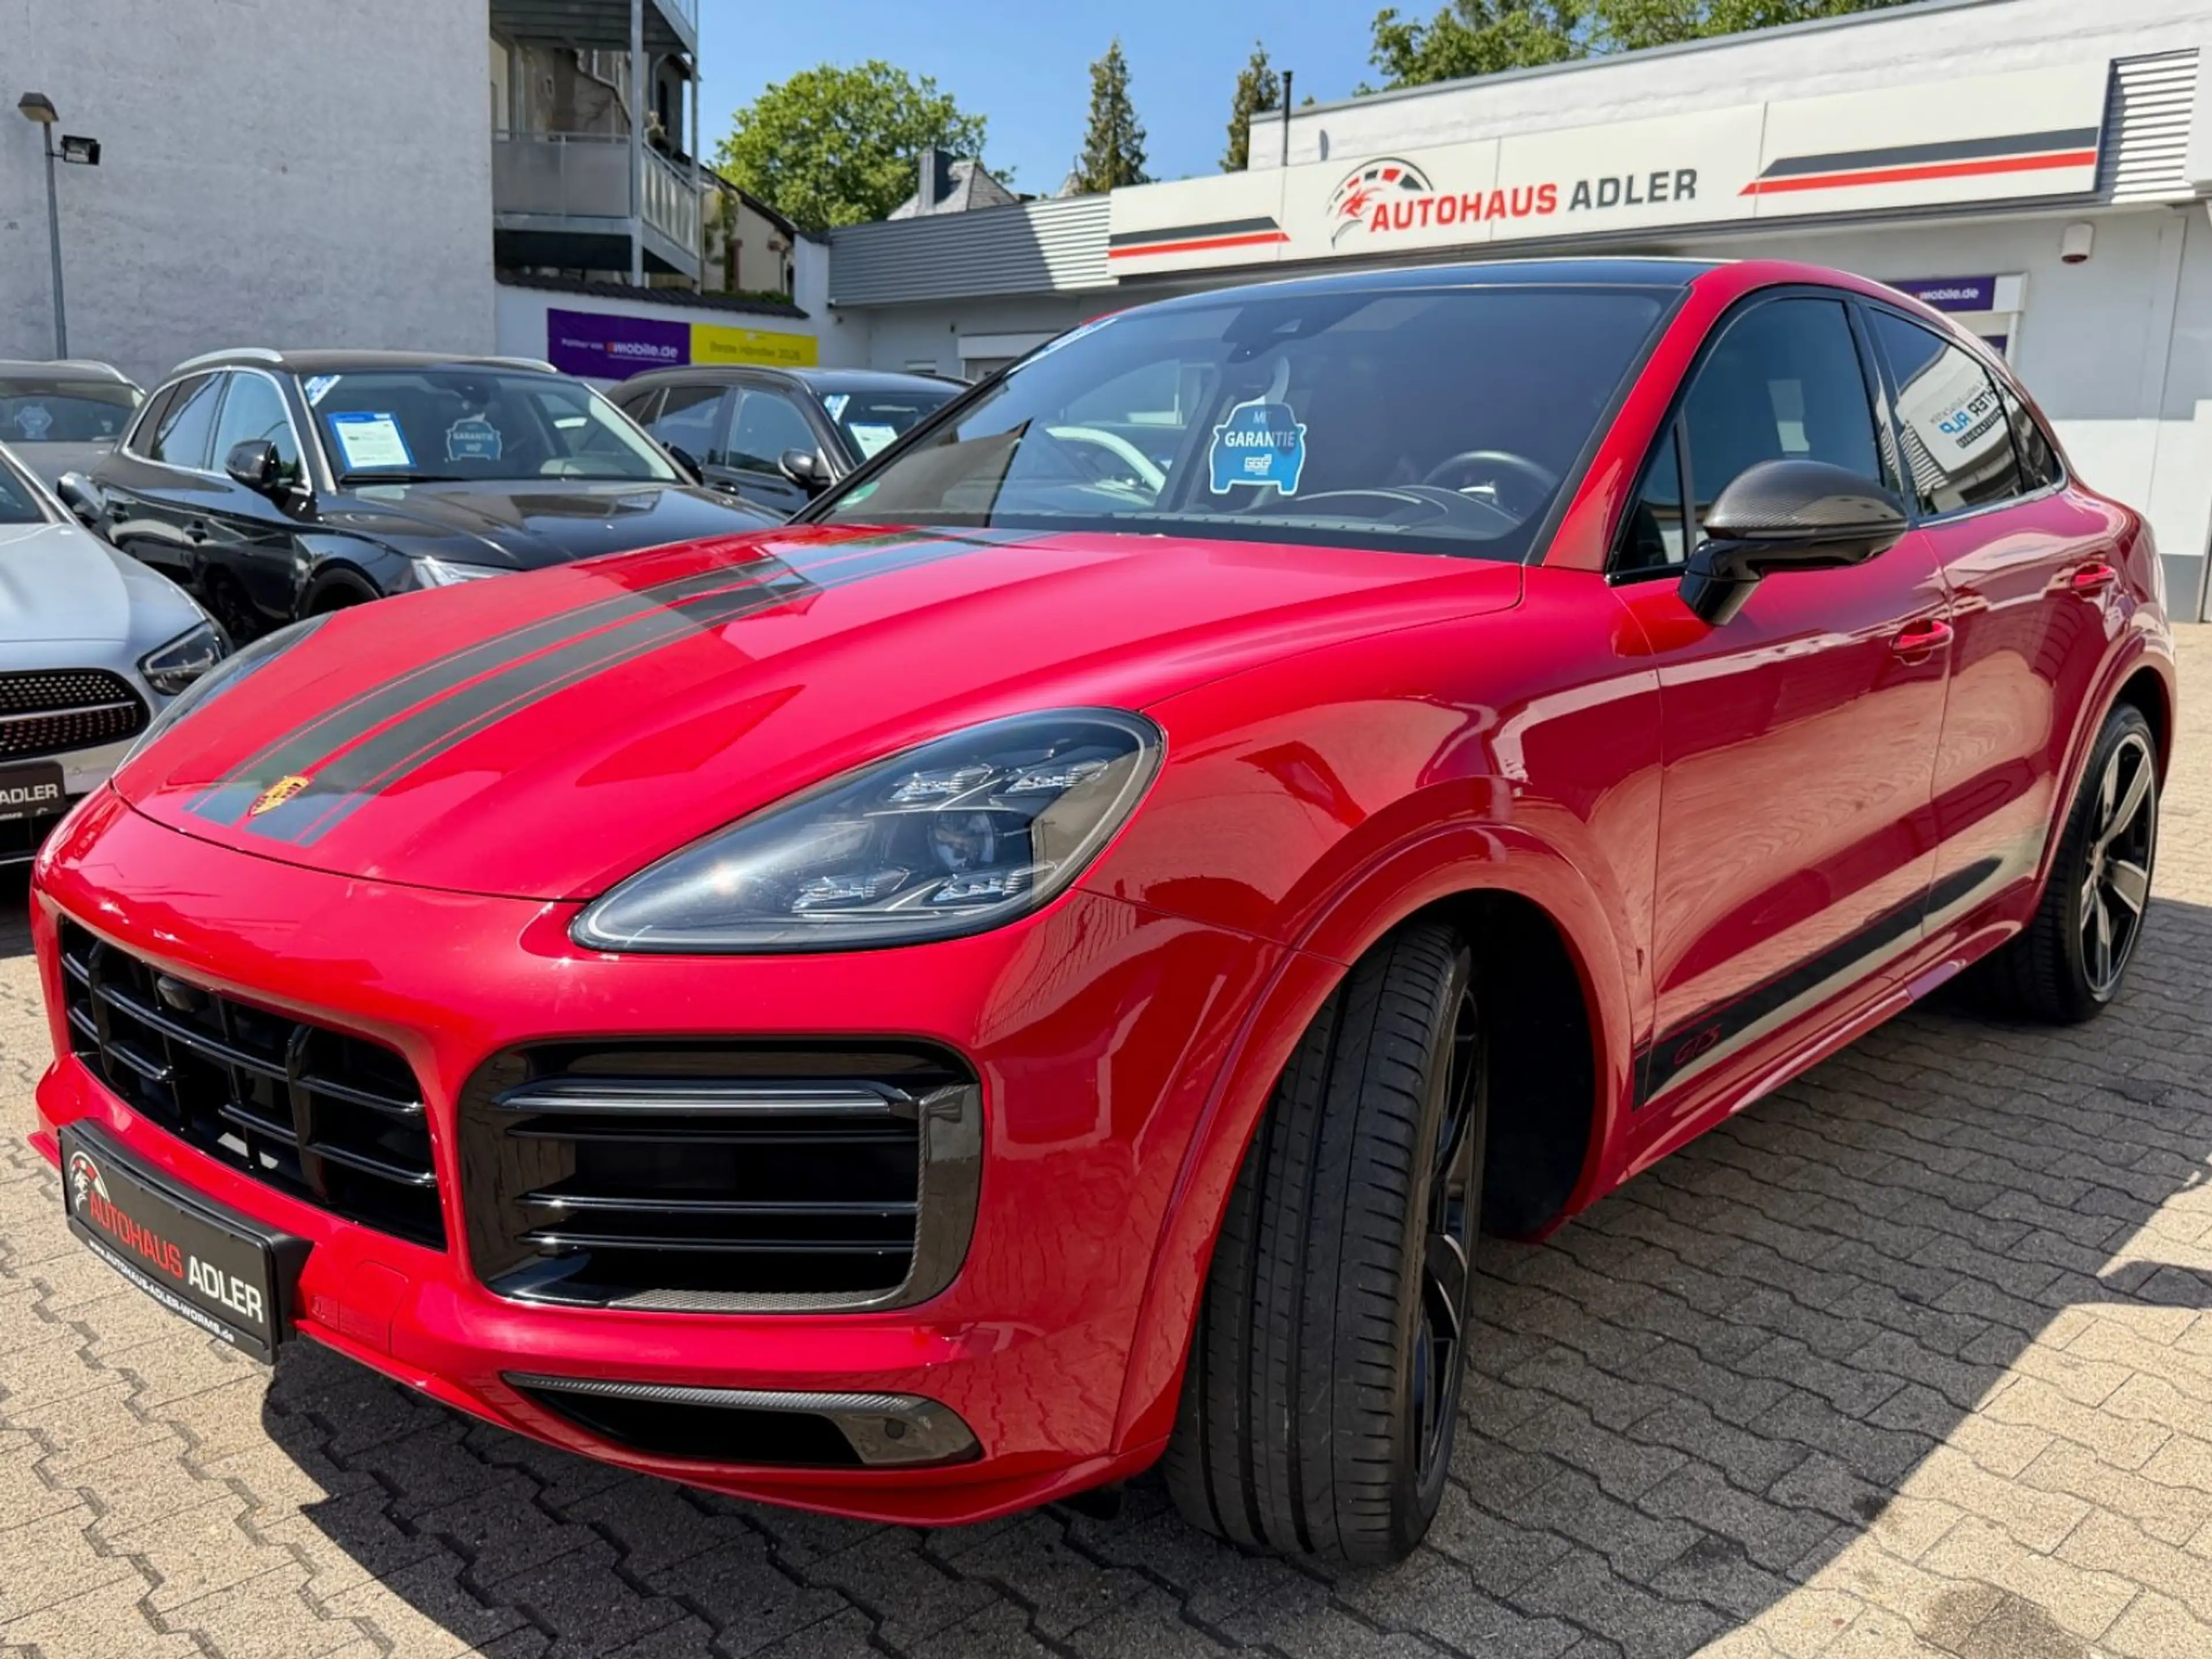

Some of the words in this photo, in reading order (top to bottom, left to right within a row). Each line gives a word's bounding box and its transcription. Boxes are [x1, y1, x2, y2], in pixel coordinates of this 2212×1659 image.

[1370, 183, 1558, 233] AUTOHAUS
[1568, 168, 1698, 211] ADLER
[1922, 288, 1979, 300] mobile.de
[615, 343, 678, 358] mobile.de
[1225, 431, 1295, 447] GARANTIE
[0, 783, 58, 804] ADLER
[90, 1190, 183, 1279] AUTOHAUS
[188, 1255, 264, 1324] ADLER
